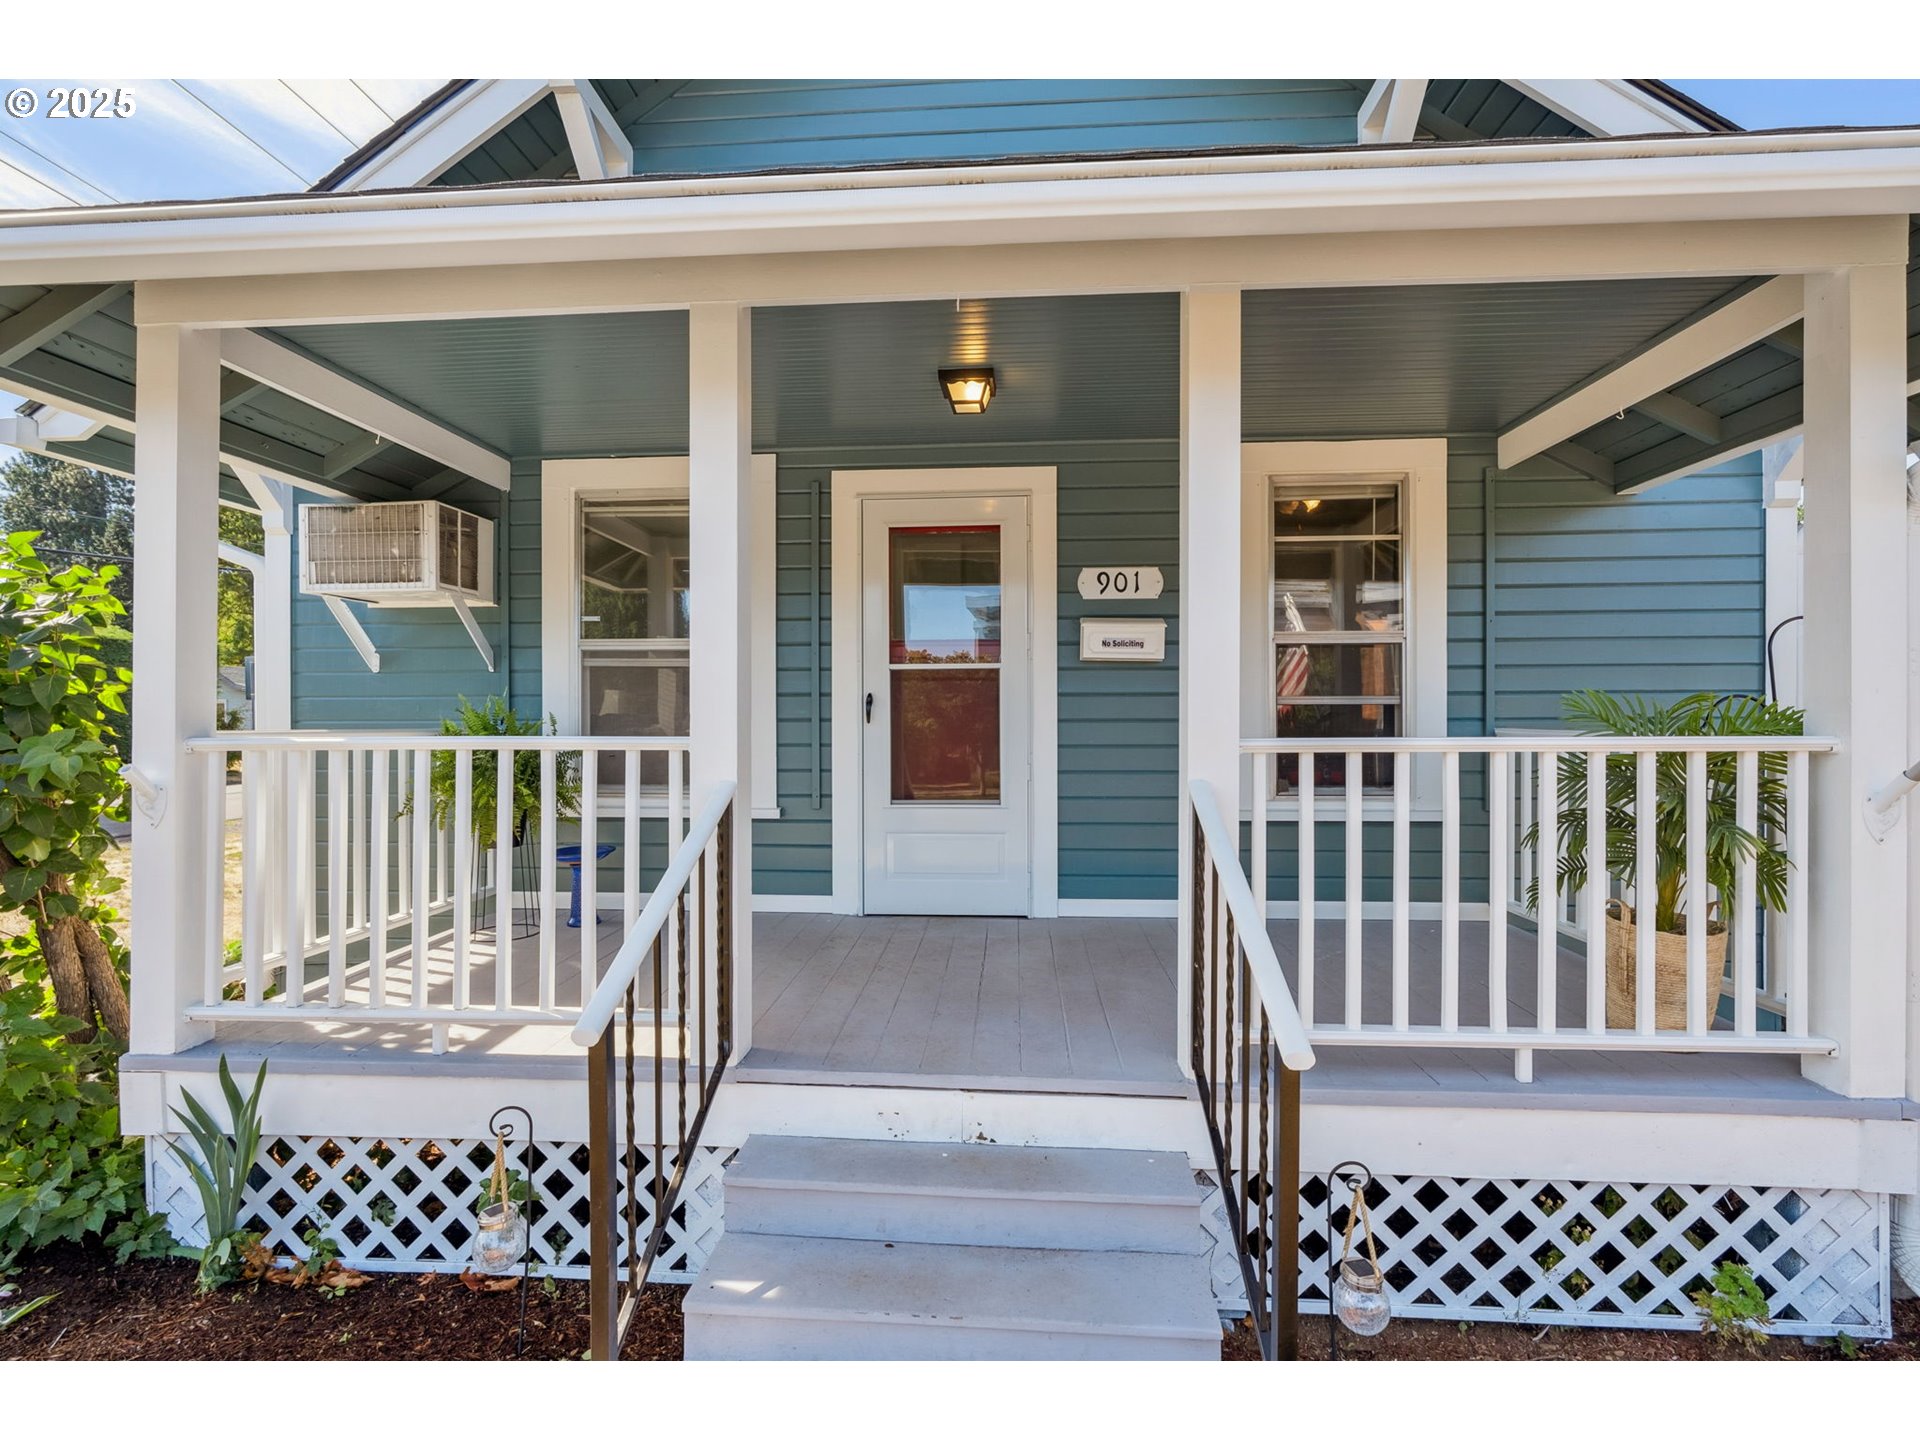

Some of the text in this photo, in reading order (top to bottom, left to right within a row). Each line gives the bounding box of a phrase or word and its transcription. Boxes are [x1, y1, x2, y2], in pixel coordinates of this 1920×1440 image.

[1096, 571, 1140, 595] 901
[1101, 639, 1145, 649] No Soliciting
